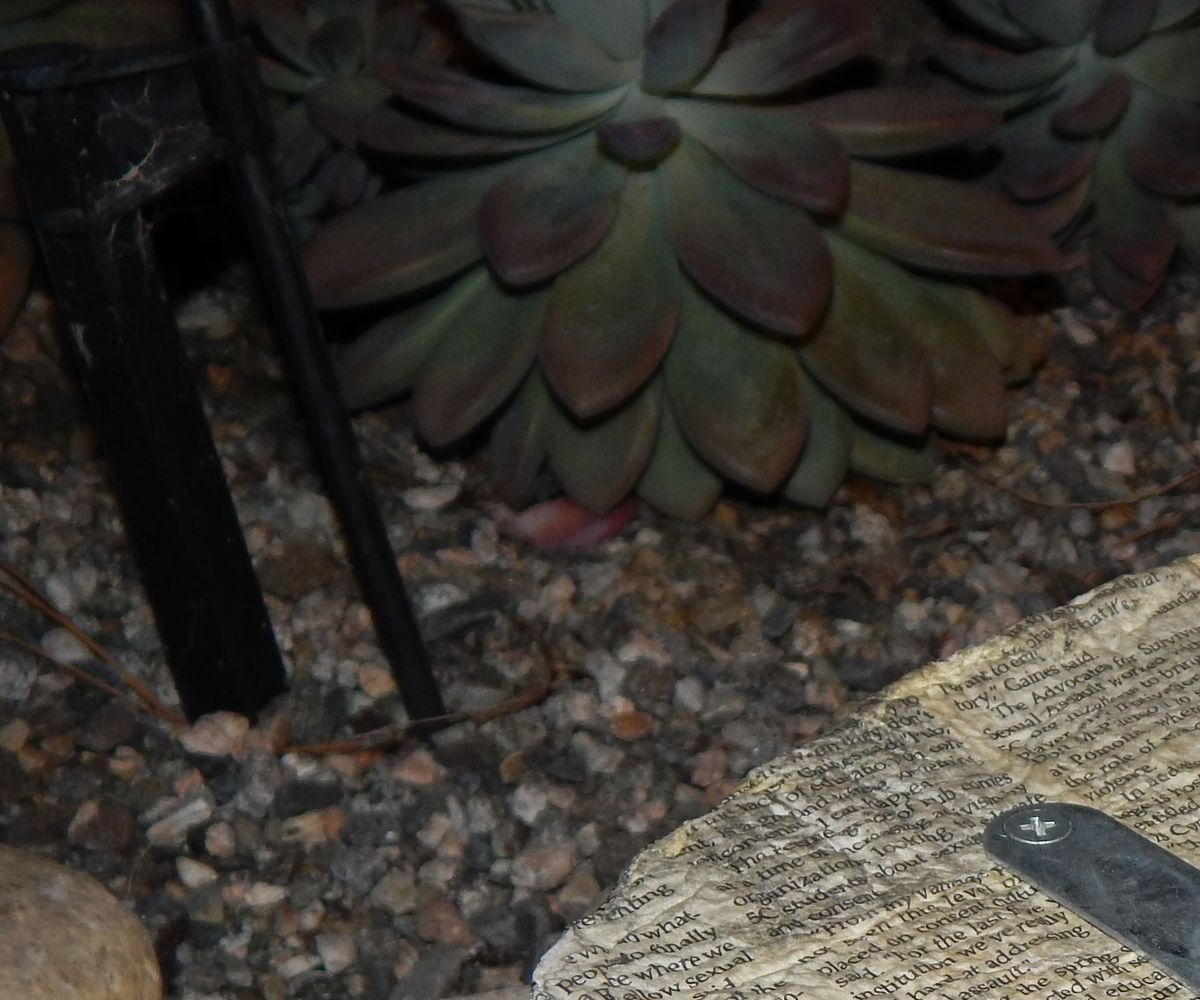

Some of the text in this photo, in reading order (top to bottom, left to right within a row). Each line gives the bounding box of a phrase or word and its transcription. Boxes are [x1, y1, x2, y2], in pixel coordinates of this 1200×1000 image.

[1003, 666, 1061, 692] Gaines
[888, 710, 935, 730] don't
[983, 712, 1042, 740] Sexual
[1045, 681, 1106, 717] Assault
[990, 699, 1028, 719] The
[1064, 738, 1159, 789] the role of
[961, 772, 1014, 792] comes
[1084, 762, 1158, 801] violence.
[1120, 786, 1146, 803] In
[871, 827, 954, 858] looking
[757, 856, 806, 881] time
[746, 907, 779, 925] 5C
[875, 853, 928, 879] about
[883, 895, 912, 911] my
[900, 884, 995, 922] this level
[641, 910, 700, 940] what-
[817, 901, 988, 977] placed on consent
[932, 930, 967, 951] the
[968, 914, 1007, 935] last
[650, 927, 717, 955] finally
[632, 941, 735, 981] where we
[685, 951, 754, 988] sexual
[850, 956, 956, 1000] institution
[958, 927, 1014, 958] we've
[962, 965, 980, 979] at
[1016, 976, 1051, 996] the
[1054, 952, 1120, 977] spring
[1084, 962, 1130, 985] with
[959, 958, 1031, 1000] assault."
[1106, 969, 1166, 997] educa
